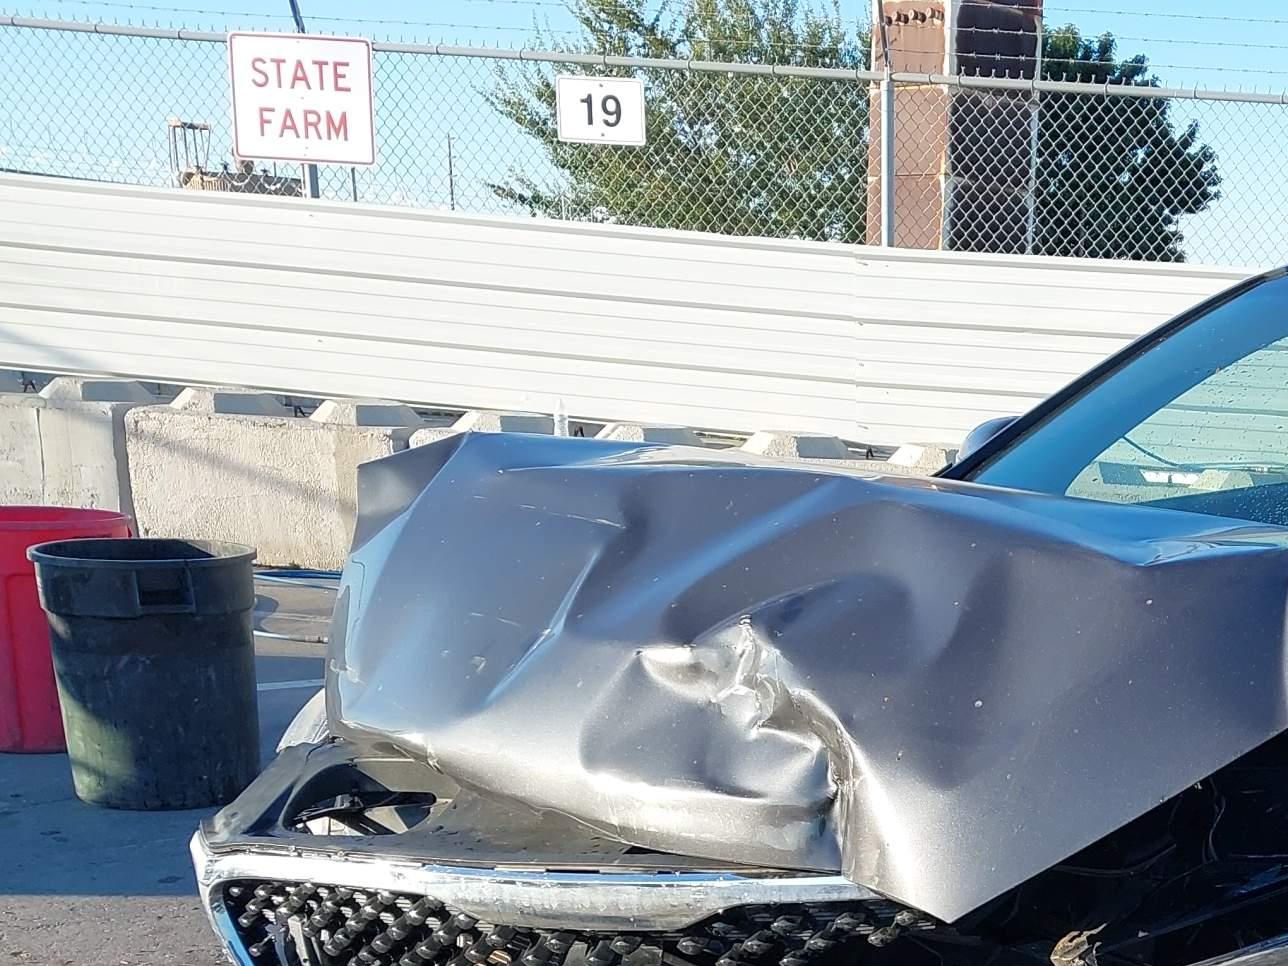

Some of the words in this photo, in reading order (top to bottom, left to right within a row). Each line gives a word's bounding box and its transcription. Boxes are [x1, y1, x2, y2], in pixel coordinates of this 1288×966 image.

[251, 57, 352, 92] STATE
[258, 107, 349, 142] FARM
[580, 93, 622, 128] 19
